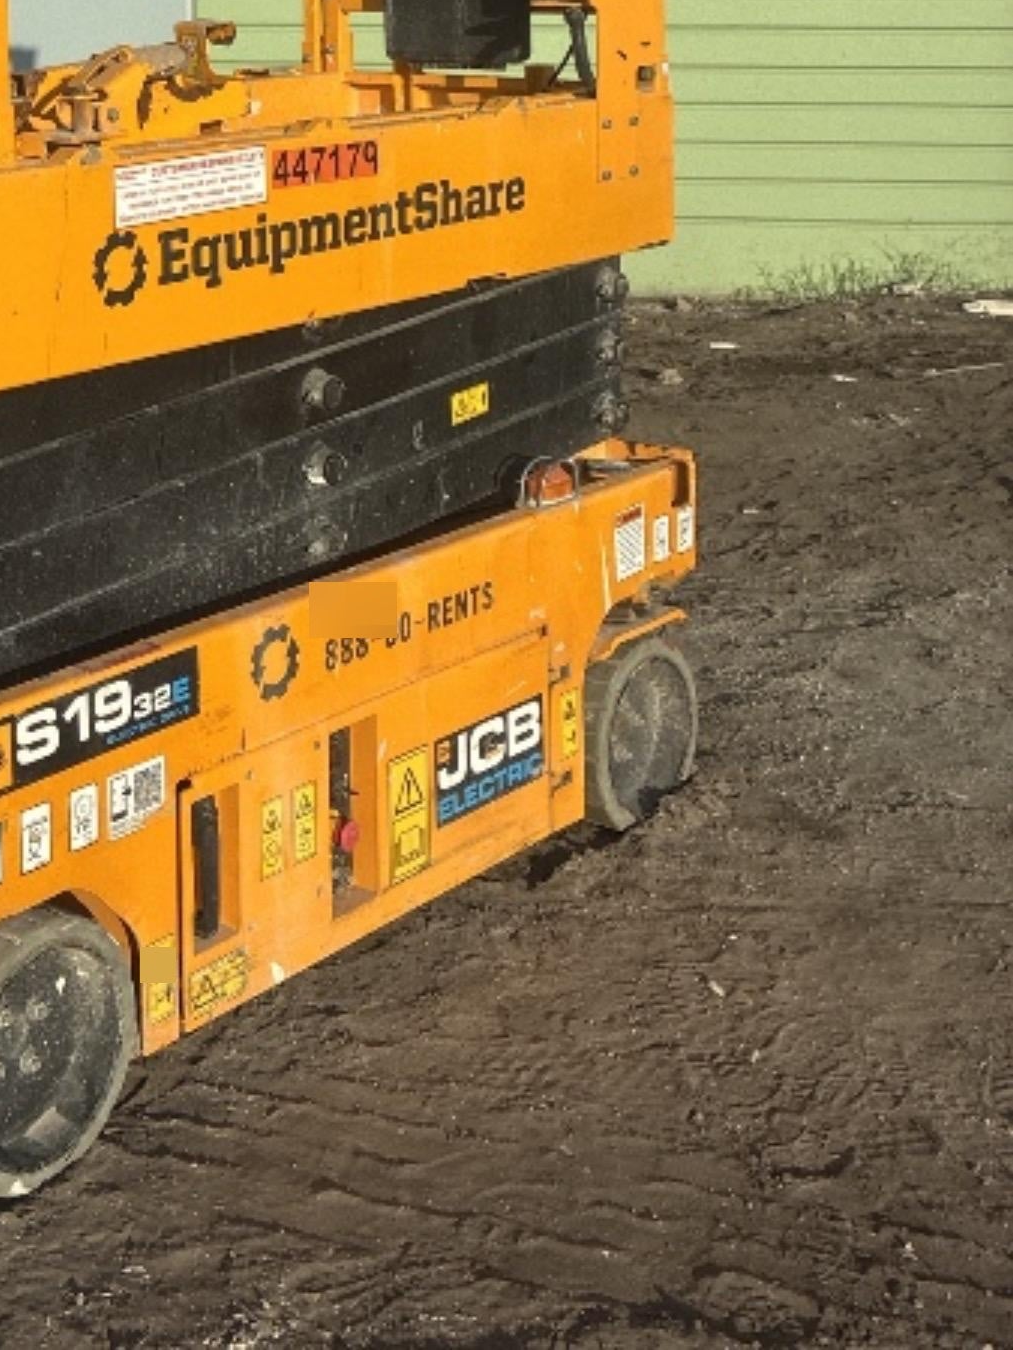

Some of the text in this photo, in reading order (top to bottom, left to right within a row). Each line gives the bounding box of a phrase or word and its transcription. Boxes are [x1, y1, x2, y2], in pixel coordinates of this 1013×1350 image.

[272, 140, 379, 187] 447179
[158, 176, 525, 289] EquipmentShare
[437, 700, 541, 790] JCB
[439, 752, 543, 823] ELECTRIC
